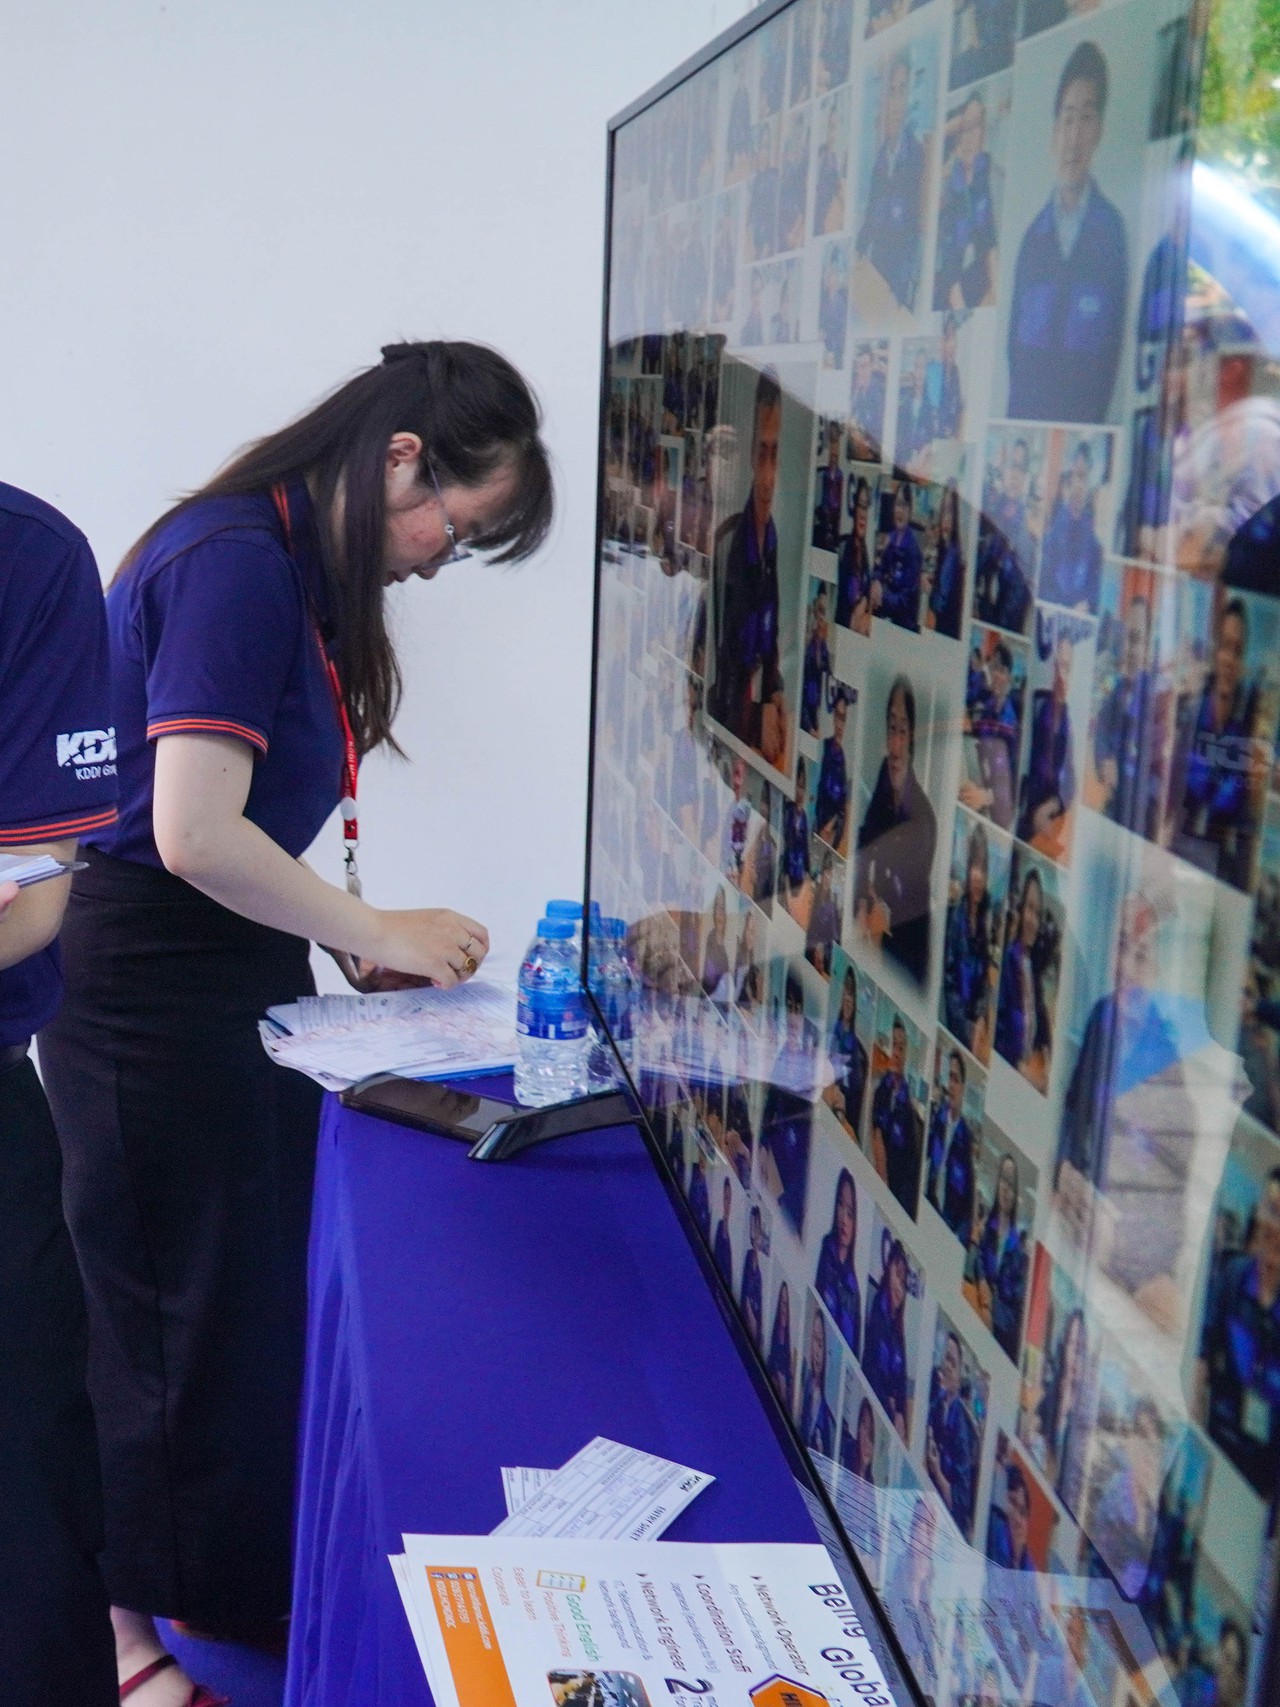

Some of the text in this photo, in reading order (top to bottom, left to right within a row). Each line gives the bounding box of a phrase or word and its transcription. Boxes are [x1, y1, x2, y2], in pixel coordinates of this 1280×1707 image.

[75, 766, 101, 780] KDDI
[553, 1623, 573, 1656] Thinking
[564, 1594, 604, 1661] Good English
[638, 1581, 687, 1671] Network Engineer
[695, 1583, 751, 1673] Coordination Staff
[753, 1584, 788, 1626] Network
[772, 1628, 810, 1675] Operator
[664, 1678, 714, 1694] 2
